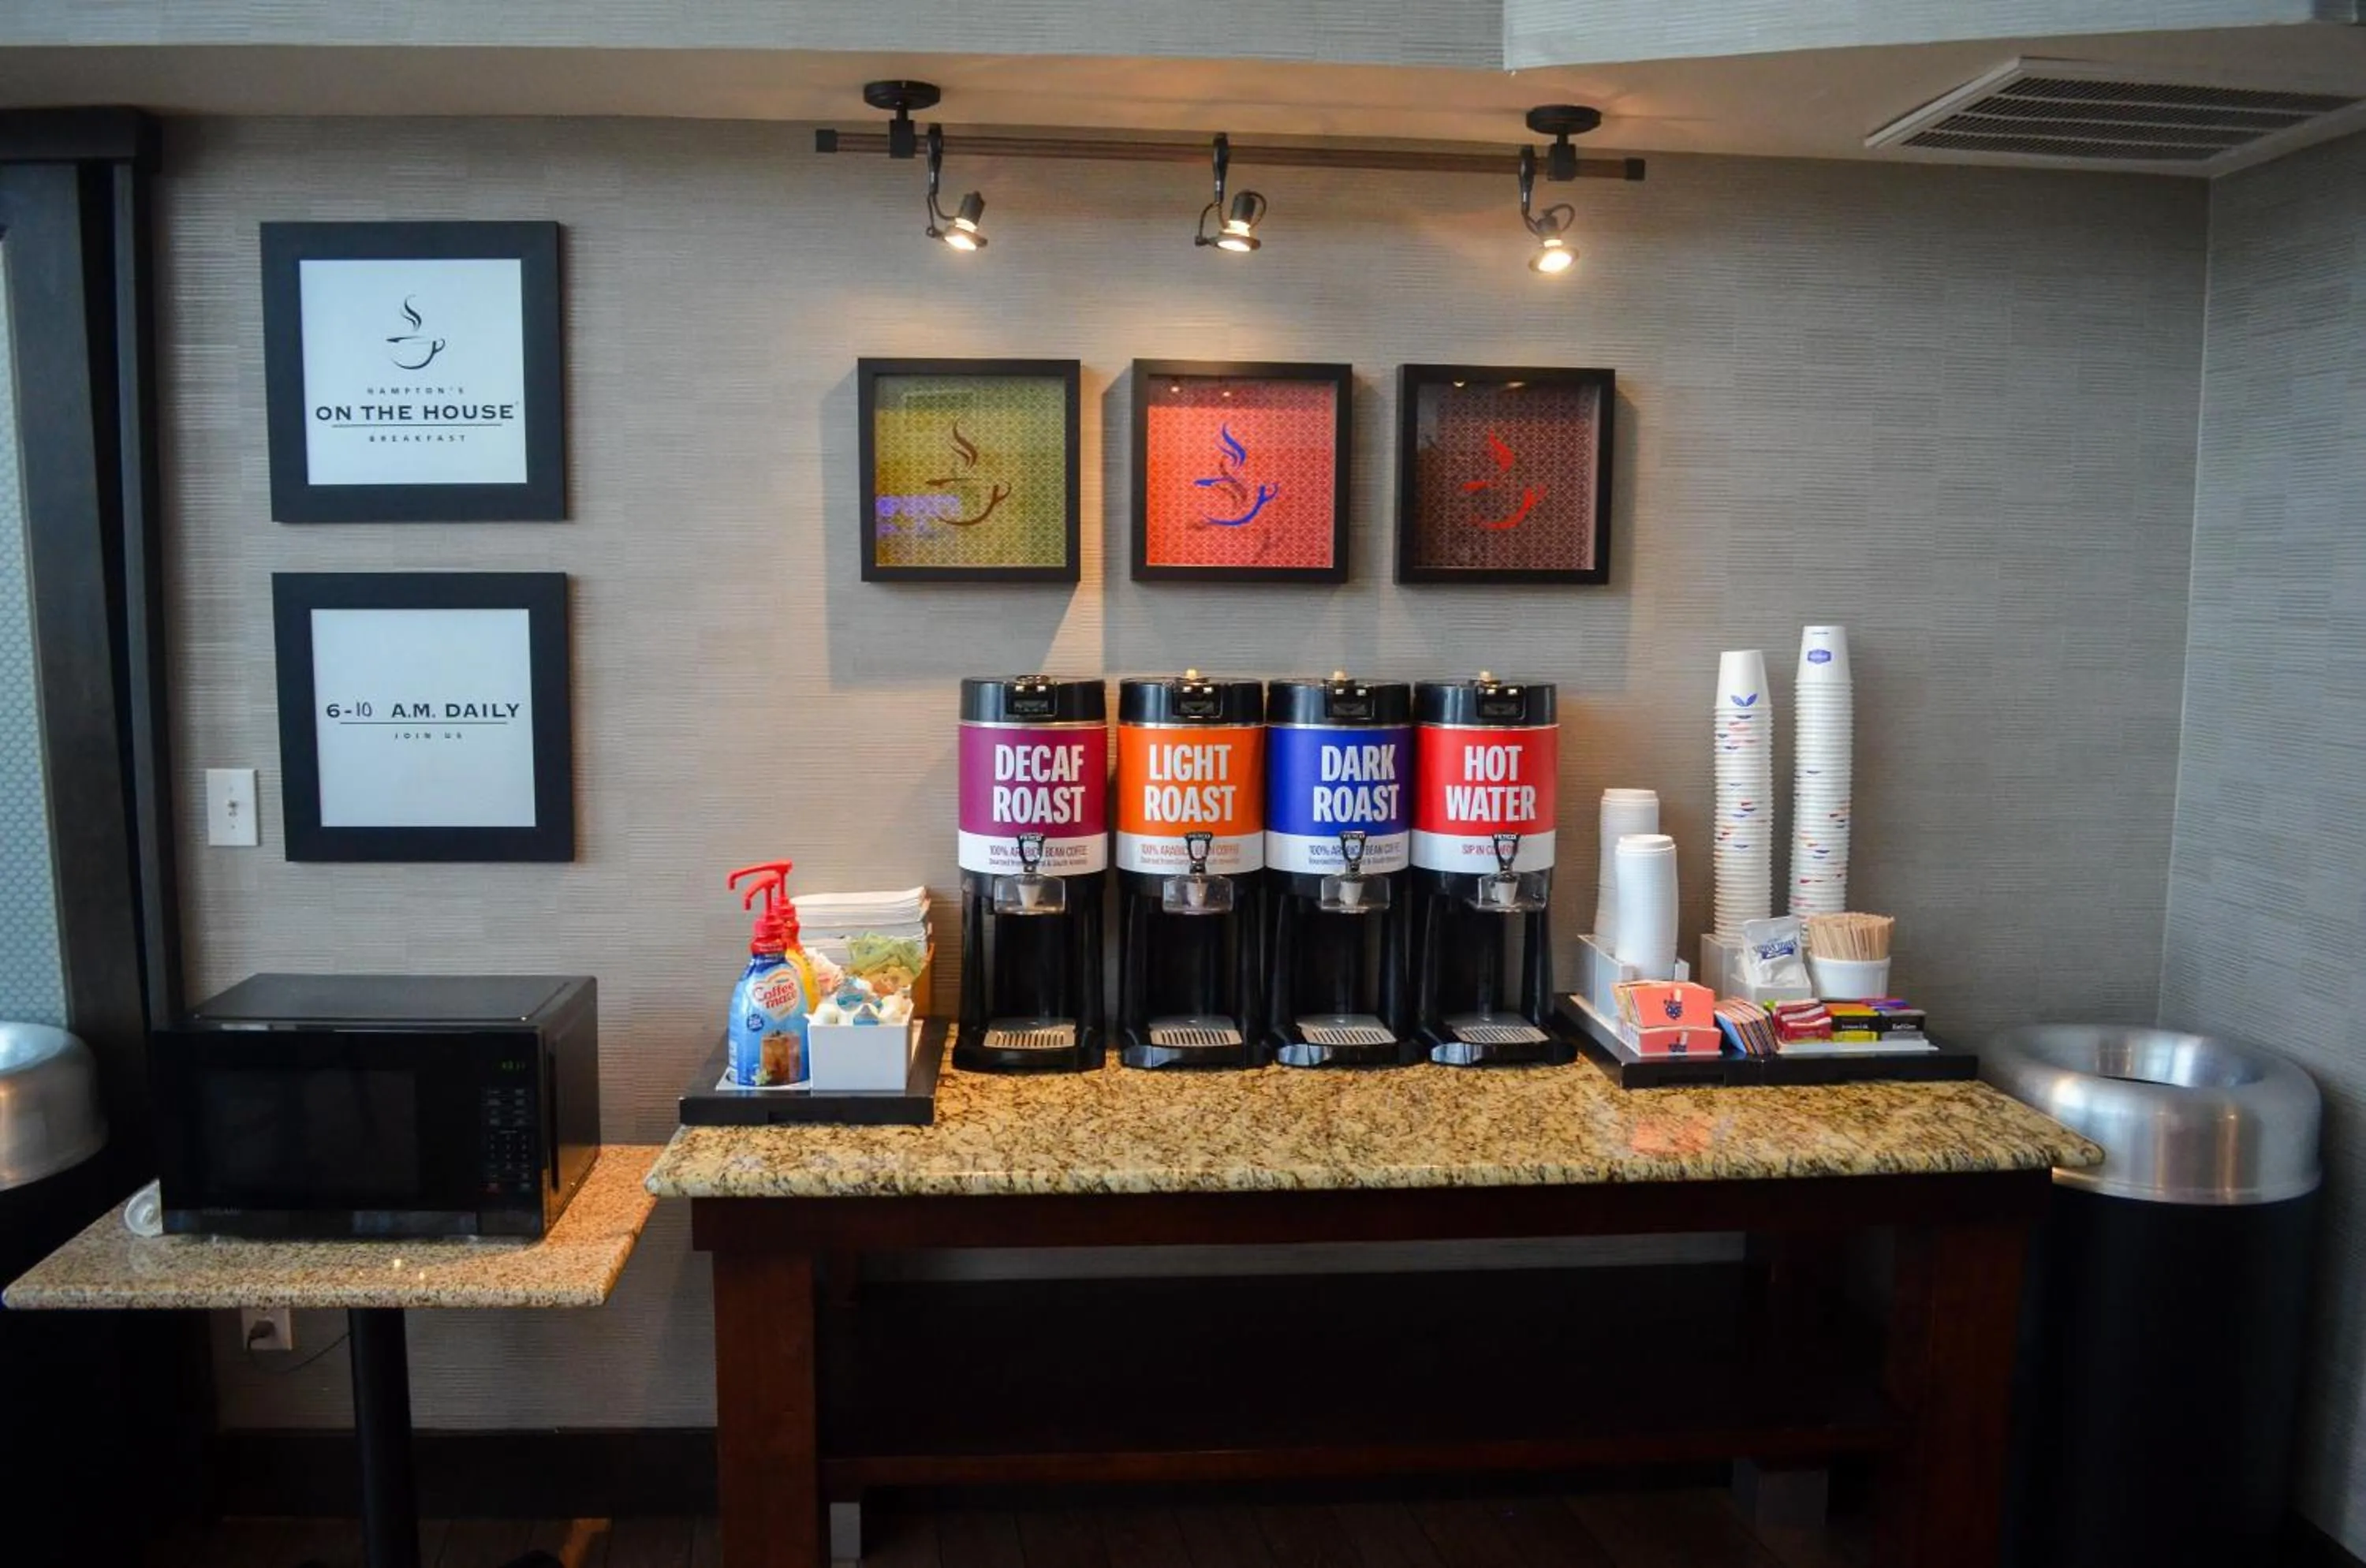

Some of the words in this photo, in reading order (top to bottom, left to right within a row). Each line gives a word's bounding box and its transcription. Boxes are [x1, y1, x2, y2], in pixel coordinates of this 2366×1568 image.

[315, 405, 352, 420] ON
[360, 405, 412, 420] THE
[423, 404, 514, 420] HOUSE
[326, 701, 373, 719] 6-10
[391, 703, 436, 719] A.M.
[444, 703, 520, 719] DAILY
[994, 745, 1085, 782] DECAF
[1148, 744, 1233, 782] LIGHT
[1320, 744, 1397, 782] DARK
[1463, 745, 1523, 782] HOT
[992, 786, 1086, 823] ROAST
[1144, 785, 1237, 823] ROAST
[1312, 784, 1400, 823] ROAST
[1445, 785, 1536, 823] WATER
[755, 982, 794, 1002] Coffee
